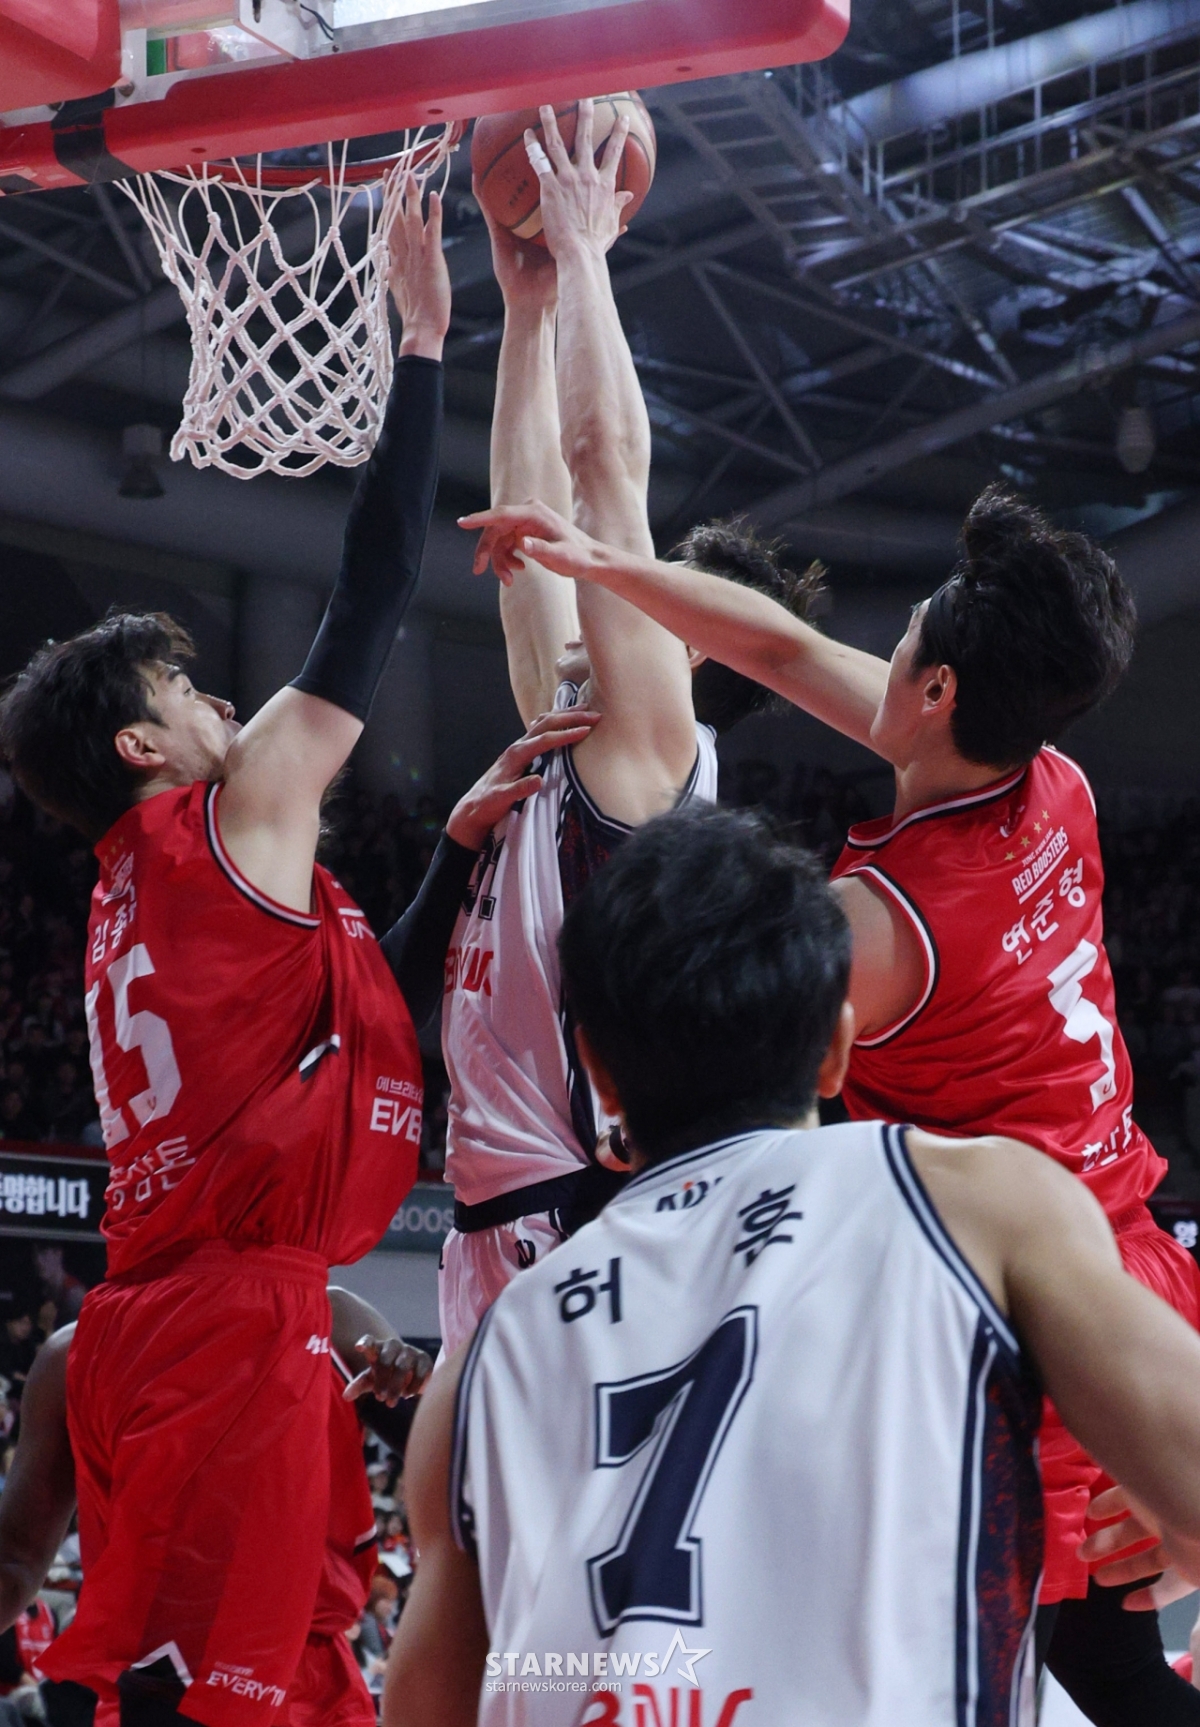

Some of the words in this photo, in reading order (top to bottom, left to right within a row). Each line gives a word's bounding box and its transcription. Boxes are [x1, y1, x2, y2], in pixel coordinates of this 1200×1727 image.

[1011, 867, 1033, 896] RED
[1031, 825, 1069, 881] BOOSTERS
[84, 942, 183, 1151] 15
[0, 1172, 91, 1219] 명합니다
[585, 1304, 760, 1640] 7
